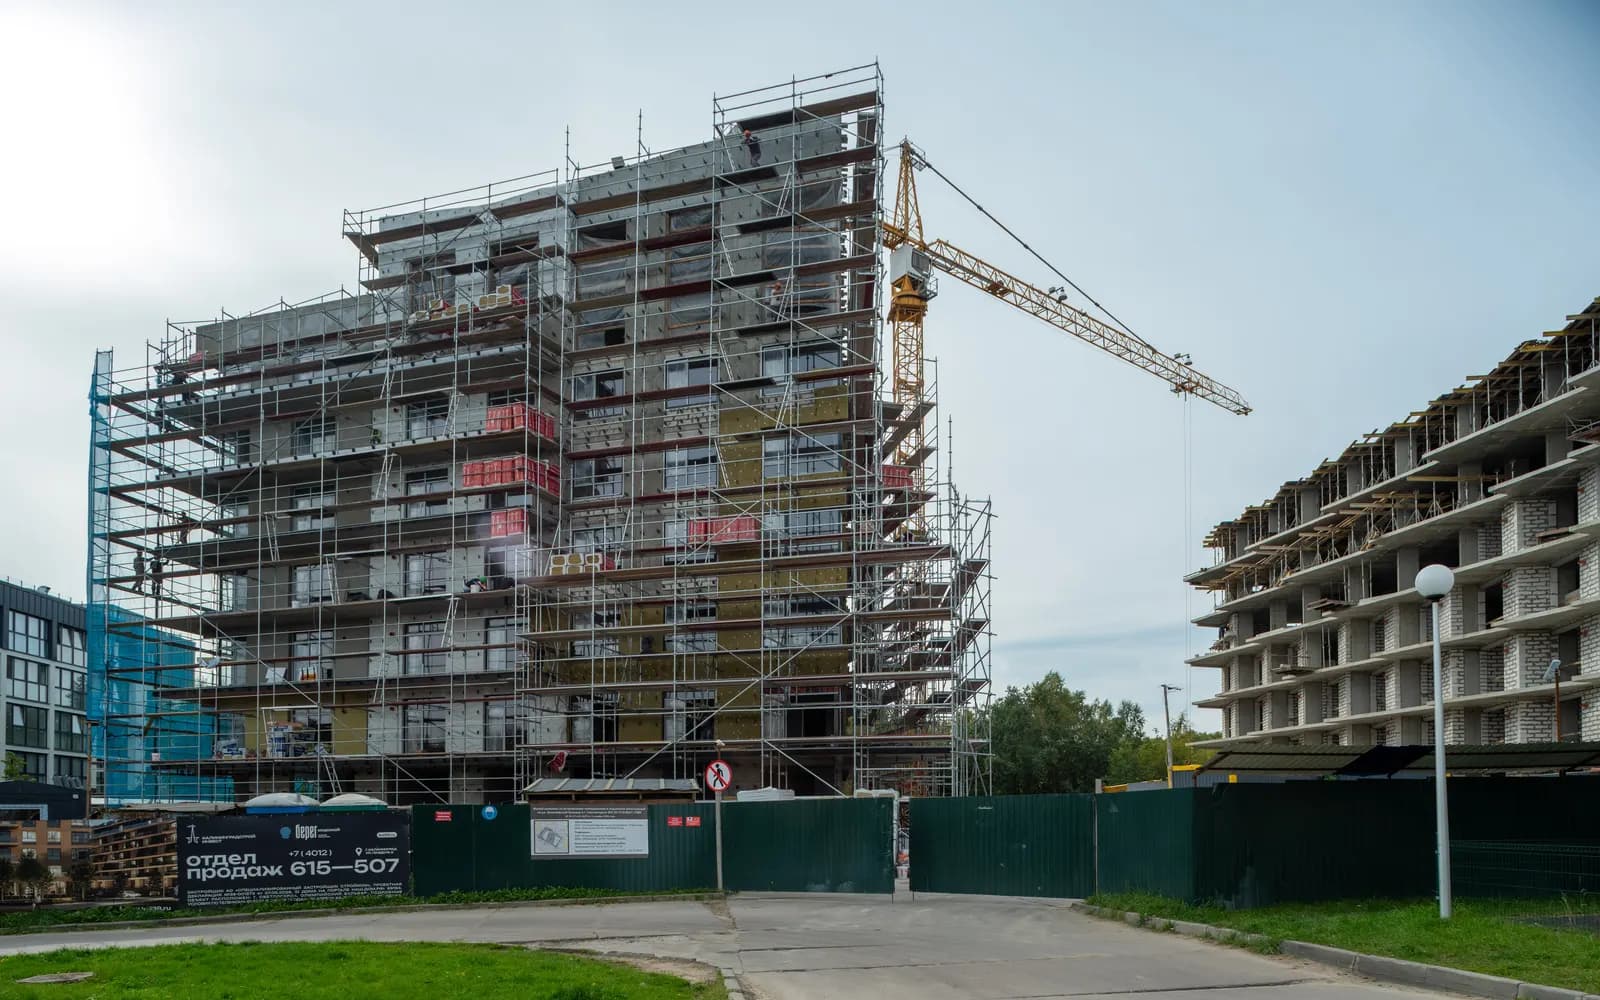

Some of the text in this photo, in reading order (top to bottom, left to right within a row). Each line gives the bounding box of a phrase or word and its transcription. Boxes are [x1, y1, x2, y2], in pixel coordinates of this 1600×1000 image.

[295, 824, 318, 840] берег
[186, 853, 257, 868] отдел
[187, 865, 283, 882] продаж
